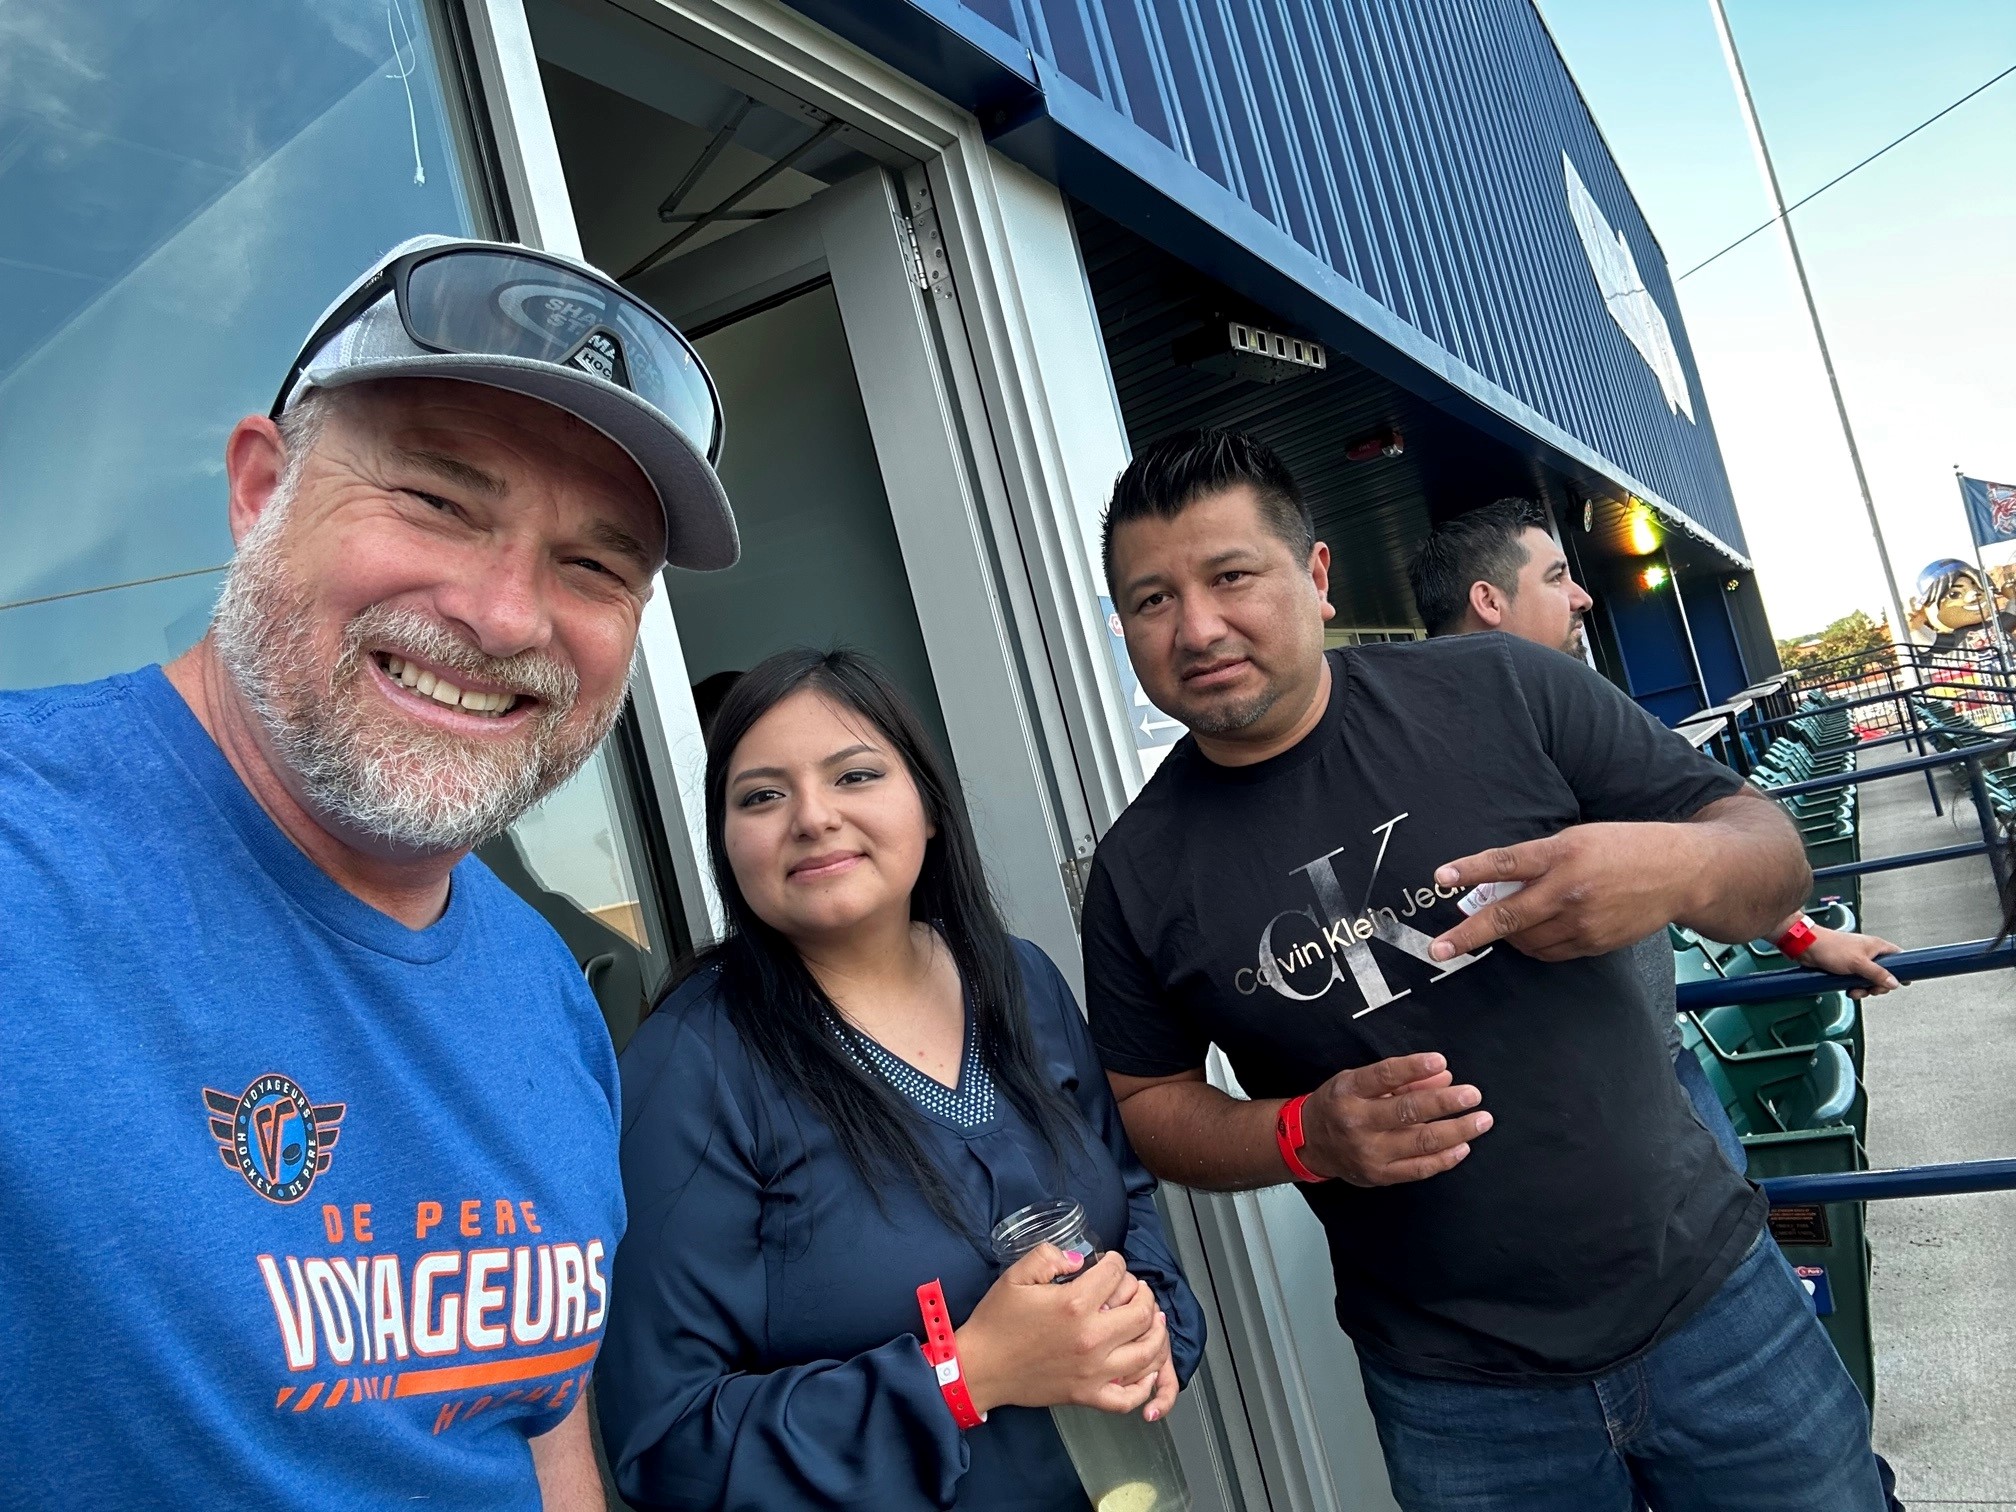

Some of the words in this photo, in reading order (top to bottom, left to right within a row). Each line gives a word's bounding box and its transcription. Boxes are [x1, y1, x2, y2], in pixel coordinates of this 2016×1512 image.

[544, 299, 603, 326] SHA
[582, 353, 611, 378] HOC
[588, 335, 616, 360] MA
[1321, 903, 1399, 954] Klein
[1400, 882, 1467, 918] Jea
[243, 1079, 311, 1119] VOYAGEURS
[237, 1132, 272, 1194] HOCKEY
[289, 1180, 304, 1196] DE
[302, 1139, 317, 1179] PERE
[322, 1203, 374, 1243] DE
[416, 1199, 542, 1239] PERE
[257, 1239, 607, 1371] VOYAGEURS
